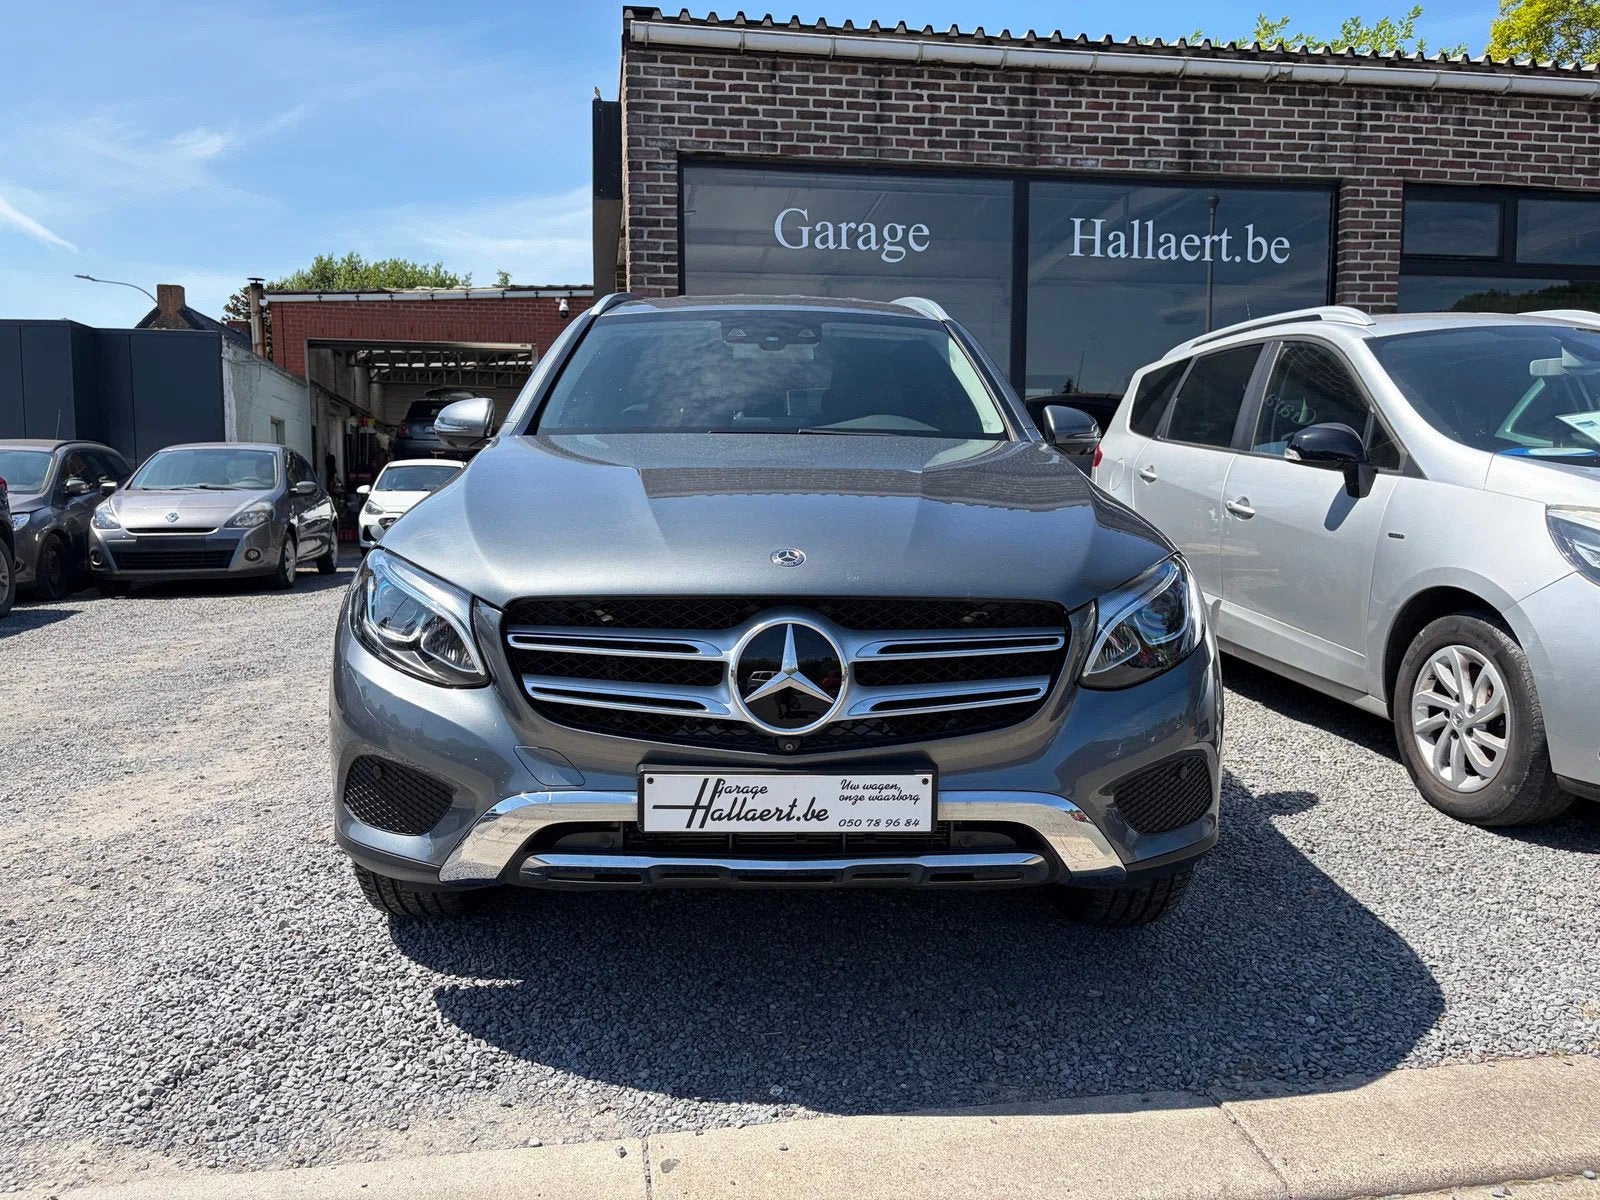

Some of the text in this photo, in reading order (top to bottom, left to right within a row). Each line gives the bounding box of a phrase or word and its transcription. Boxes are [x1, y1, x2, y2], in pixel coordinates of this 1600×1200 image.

[774, 207, 1291, 265] Garage Hallaert.be
[715, 778, 769, 800] Garage
[840, 778, 903, 794] Uw wagen,
[651, 777, 830, 829] Hallaert.be
[838, 790, 921, 806] onze waarborg
[838, 818, 920, 828] 050 78 96 84
